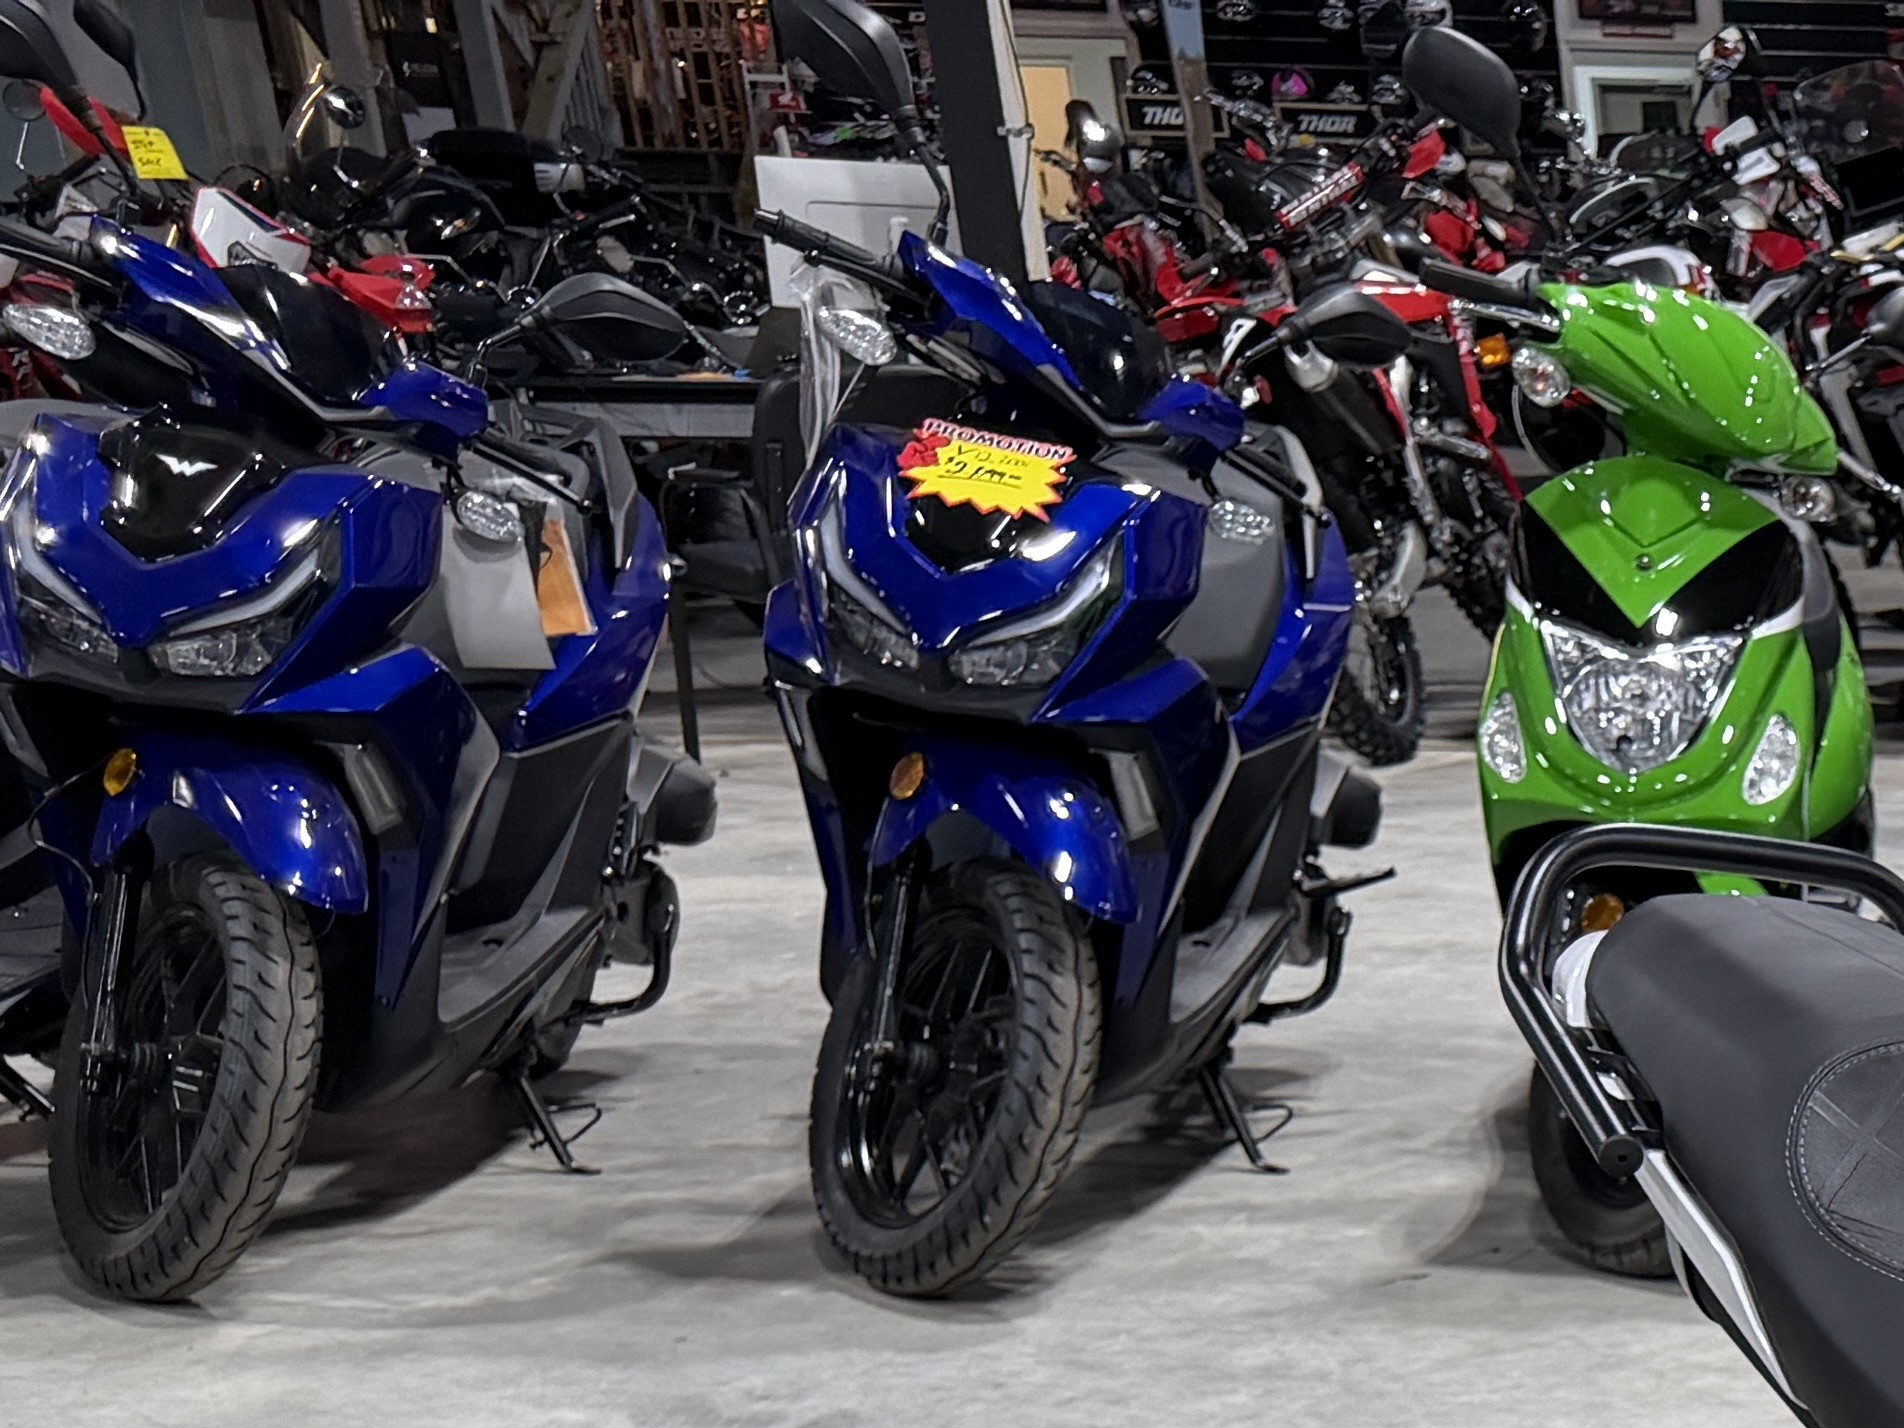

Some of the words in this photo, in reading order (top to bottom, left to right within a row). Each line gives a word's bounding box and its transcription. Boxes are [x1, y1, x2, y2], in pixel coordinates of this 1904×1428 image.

[1142, 105, 1186, 126] THO
[1297, 113, 1358, 134] THOR
[922, 419, 1067, 460] PROMOTION
